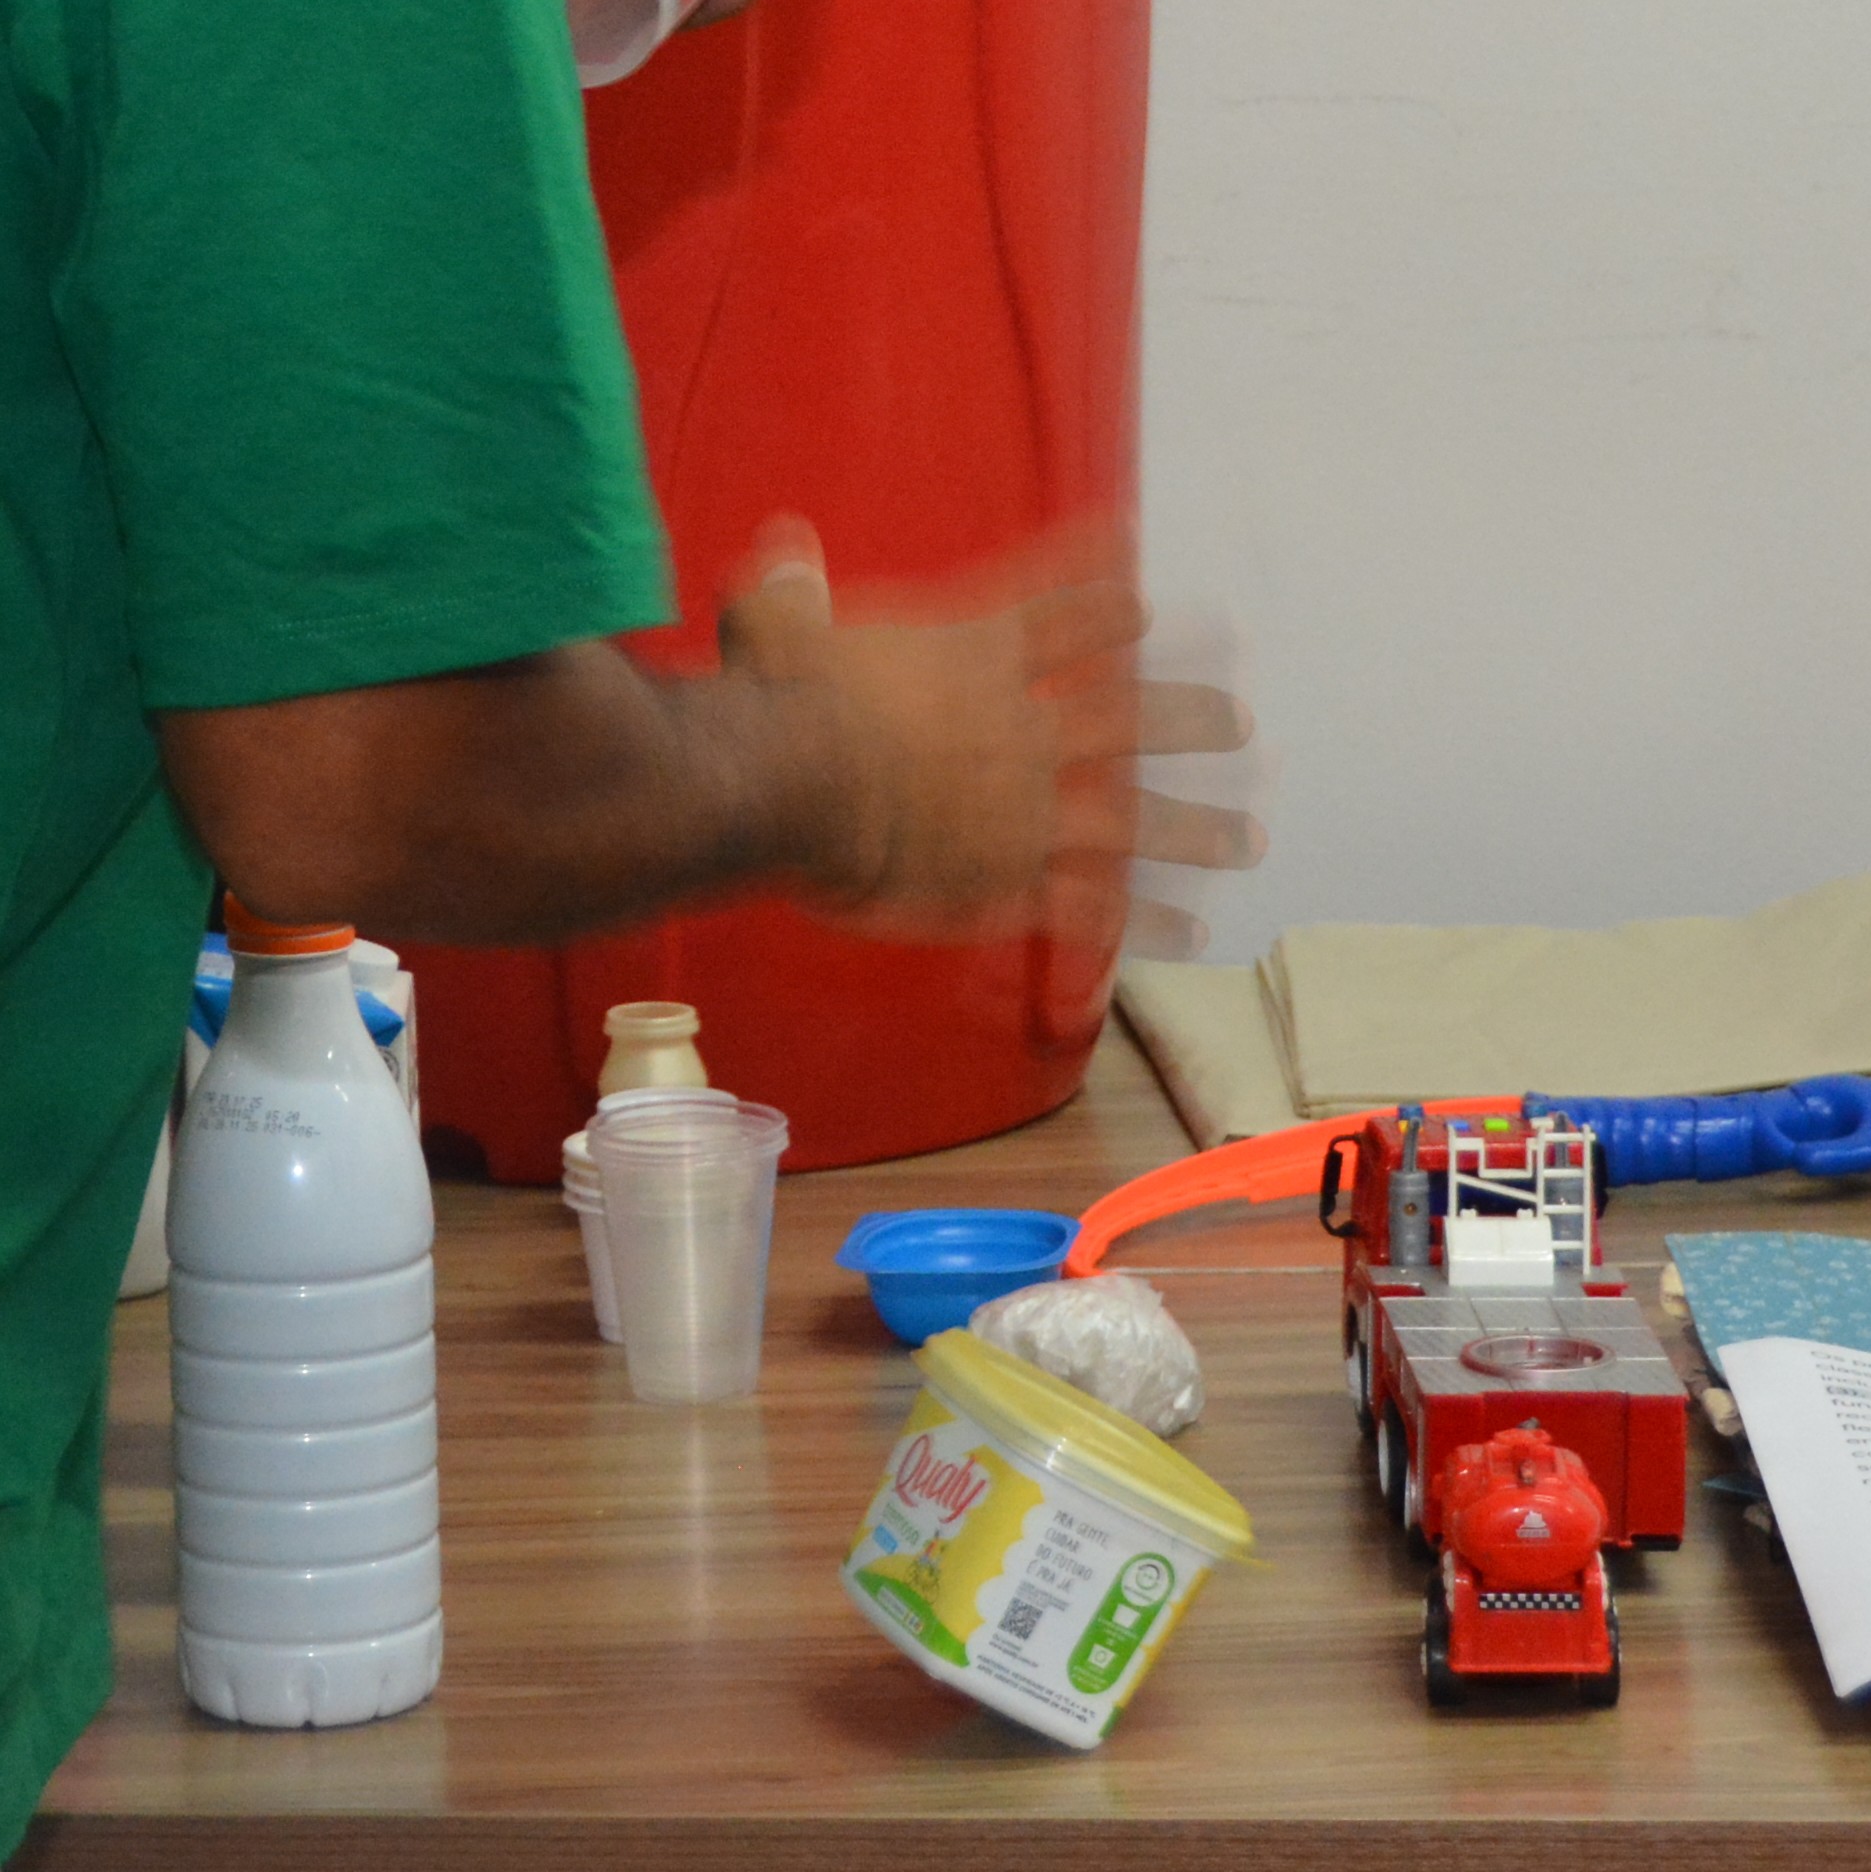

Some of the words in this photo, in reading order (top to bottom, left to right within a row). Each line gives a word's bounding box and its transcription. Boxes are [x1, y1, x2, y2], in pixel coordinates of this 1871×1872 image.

[893, 1434, 987, 1525] Qualy
[1053, 1509, 1074, 1529] PRA
[1053, 1552, 1094, 1582] FUTURO
